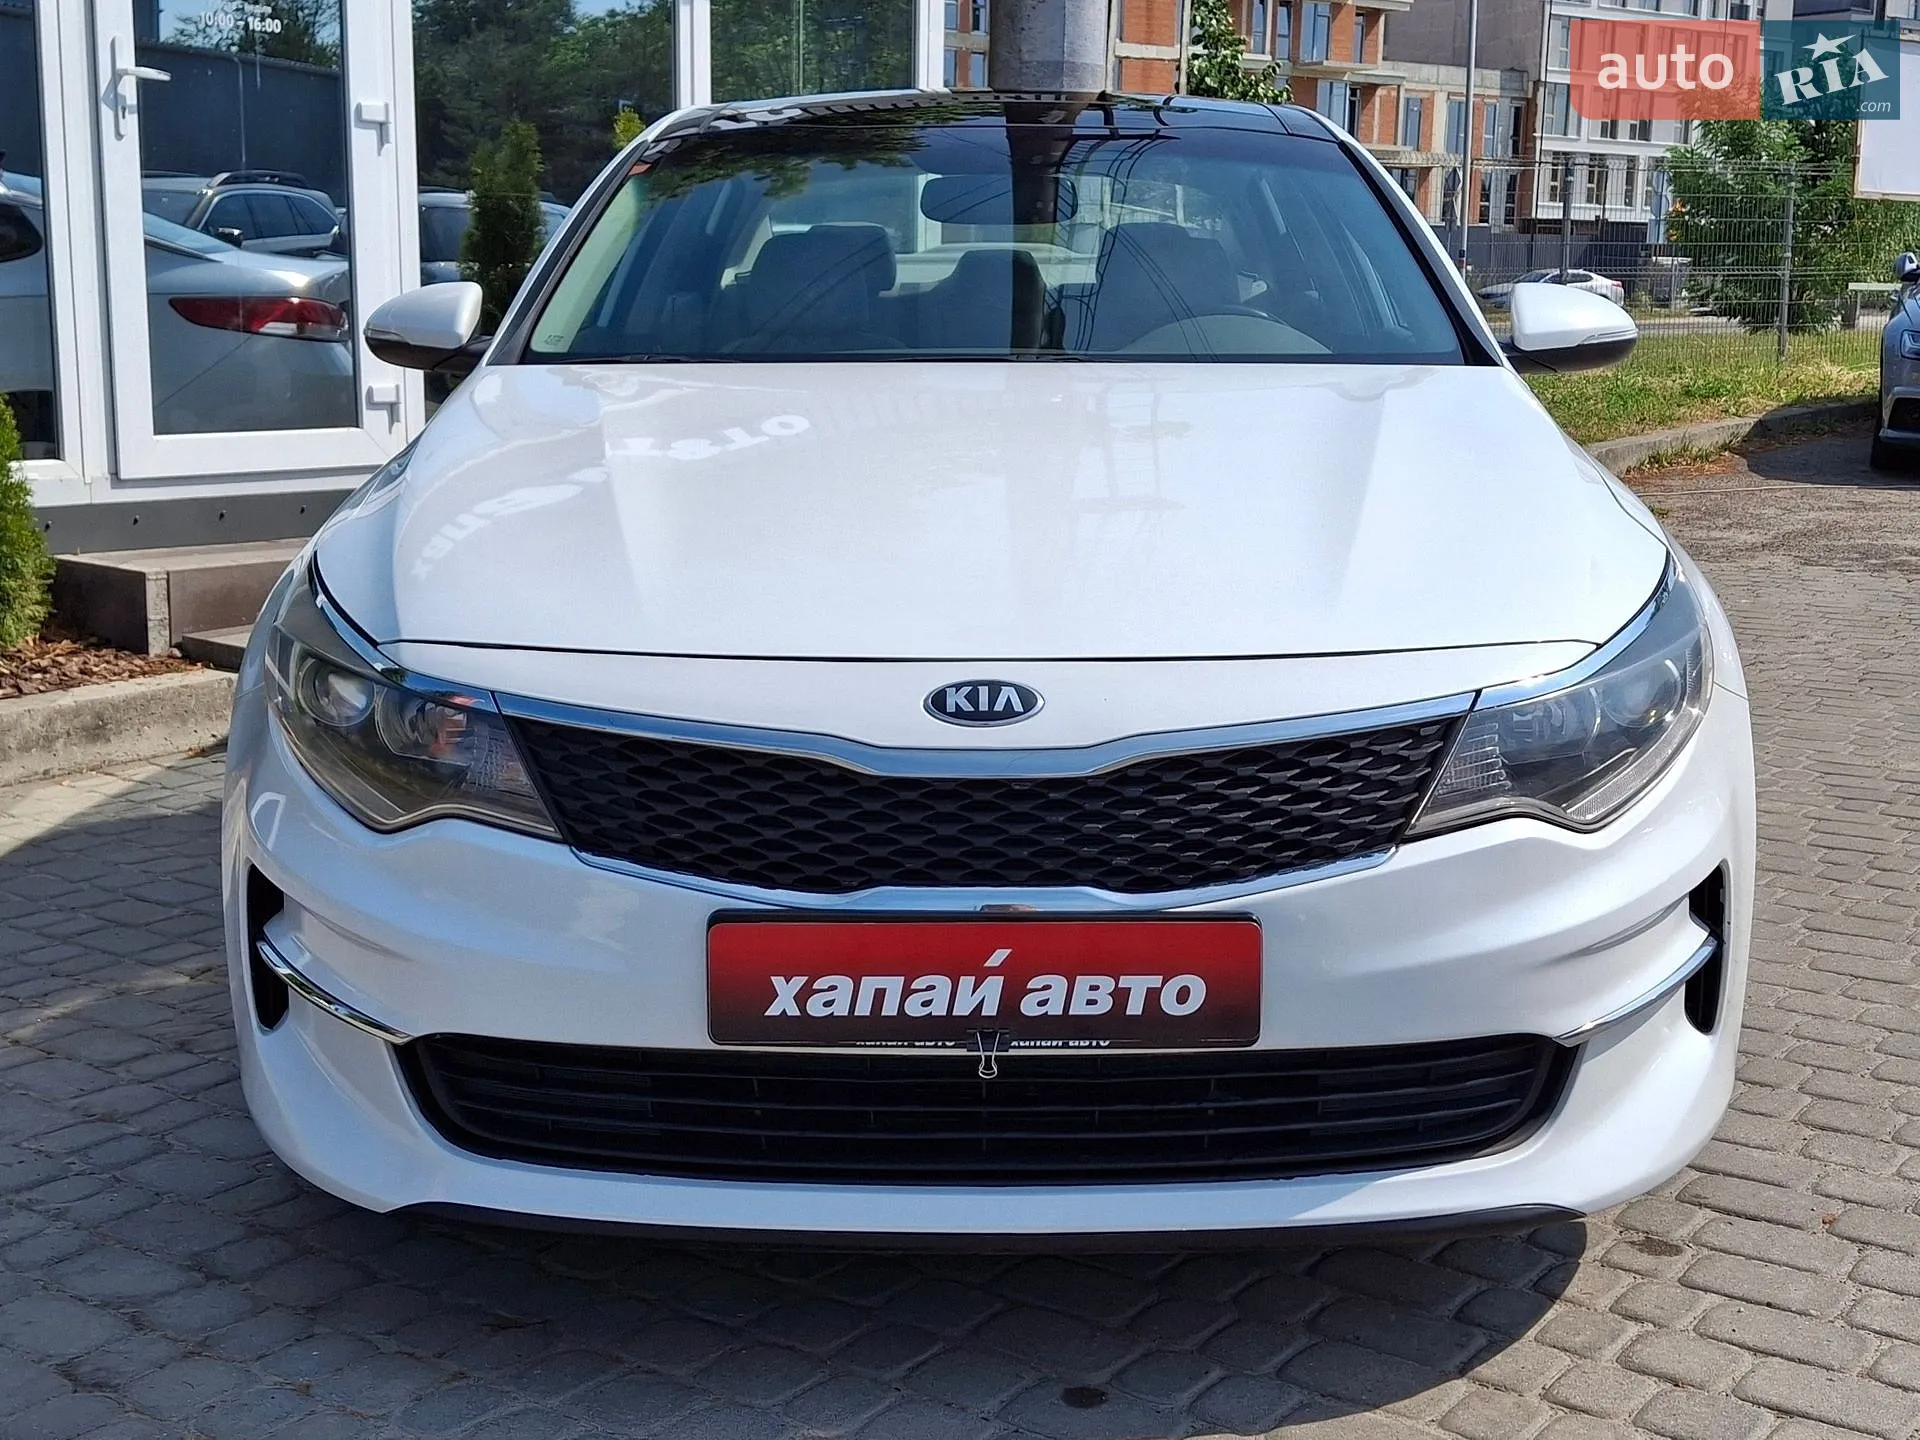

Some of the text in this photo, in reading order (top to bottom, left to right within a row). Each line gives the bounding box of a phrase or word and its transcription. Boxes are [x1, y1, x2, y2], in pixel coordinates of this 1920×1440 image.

[247, 15, 281, 33] 16:00
[945, 685, 1025, 712] KIA
[1020, 974, 1207, 1016] авто
